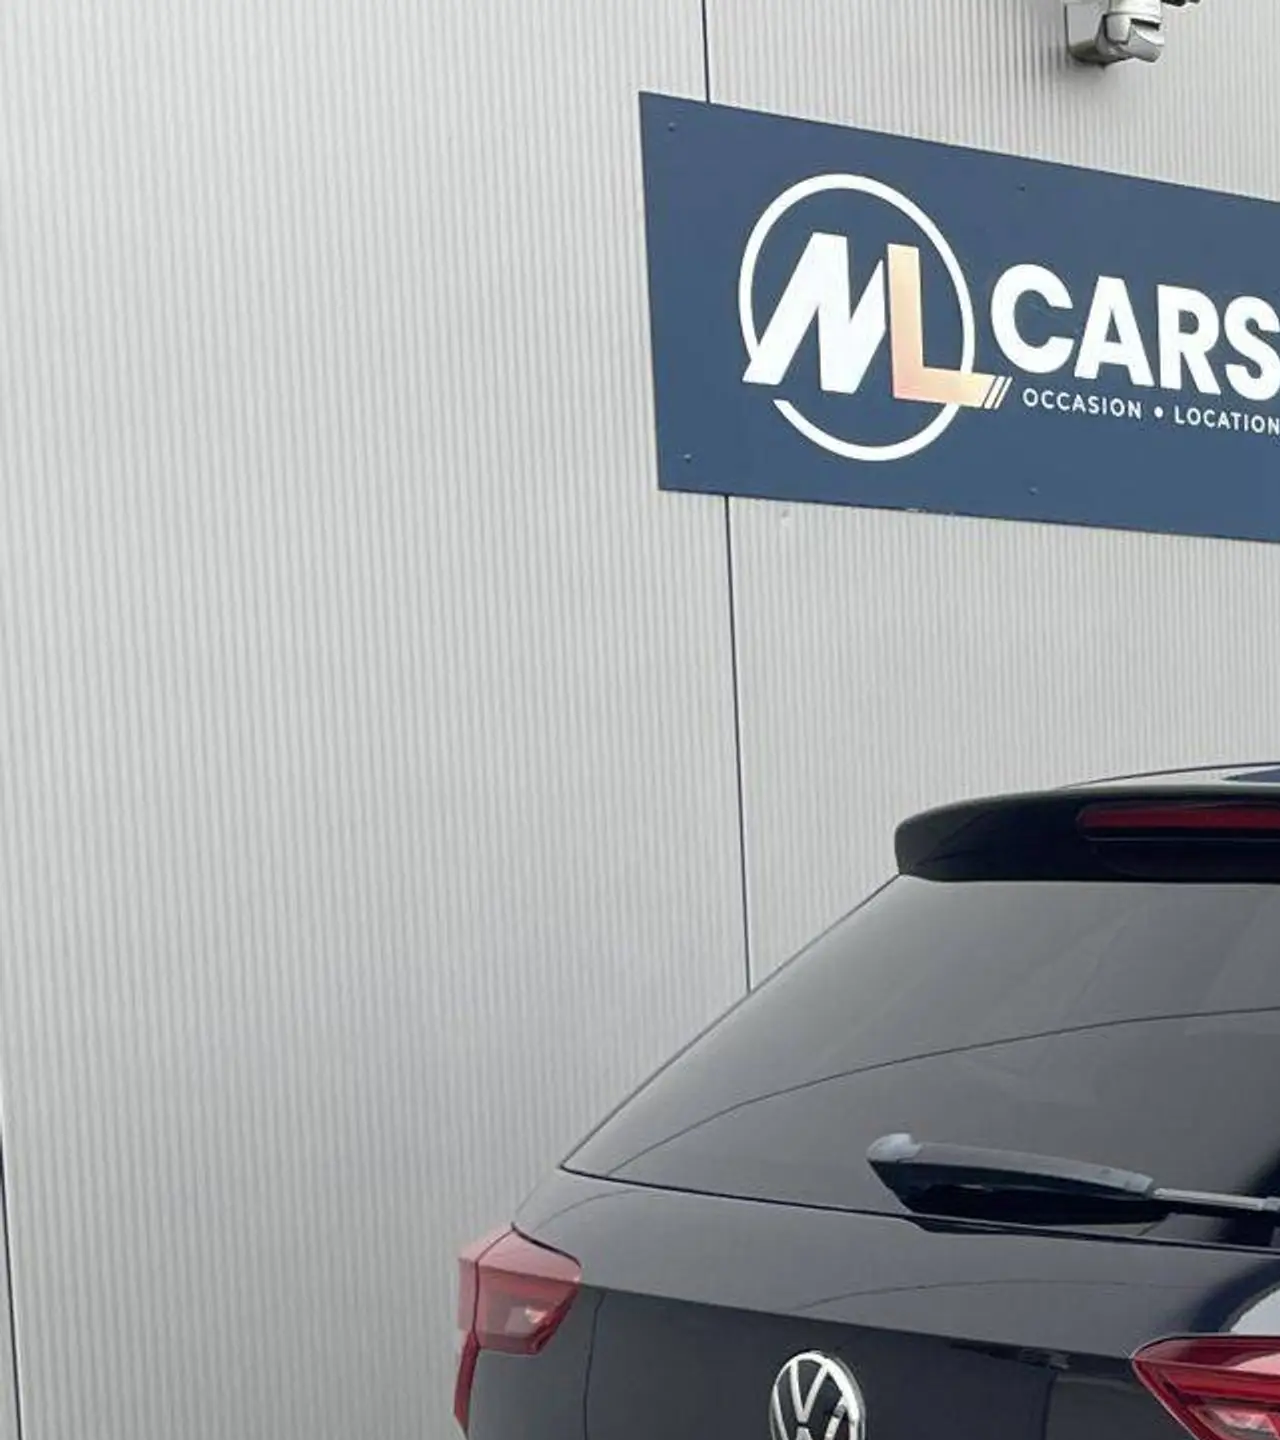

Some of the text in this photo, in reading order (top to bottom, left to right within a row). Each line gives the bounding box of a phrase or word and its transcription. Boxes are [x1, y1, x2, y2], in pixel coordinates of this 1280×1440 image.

[742, 231, 1008, 409] ML
[1022, 388, 1280, 437] OCCASION LOCATION
